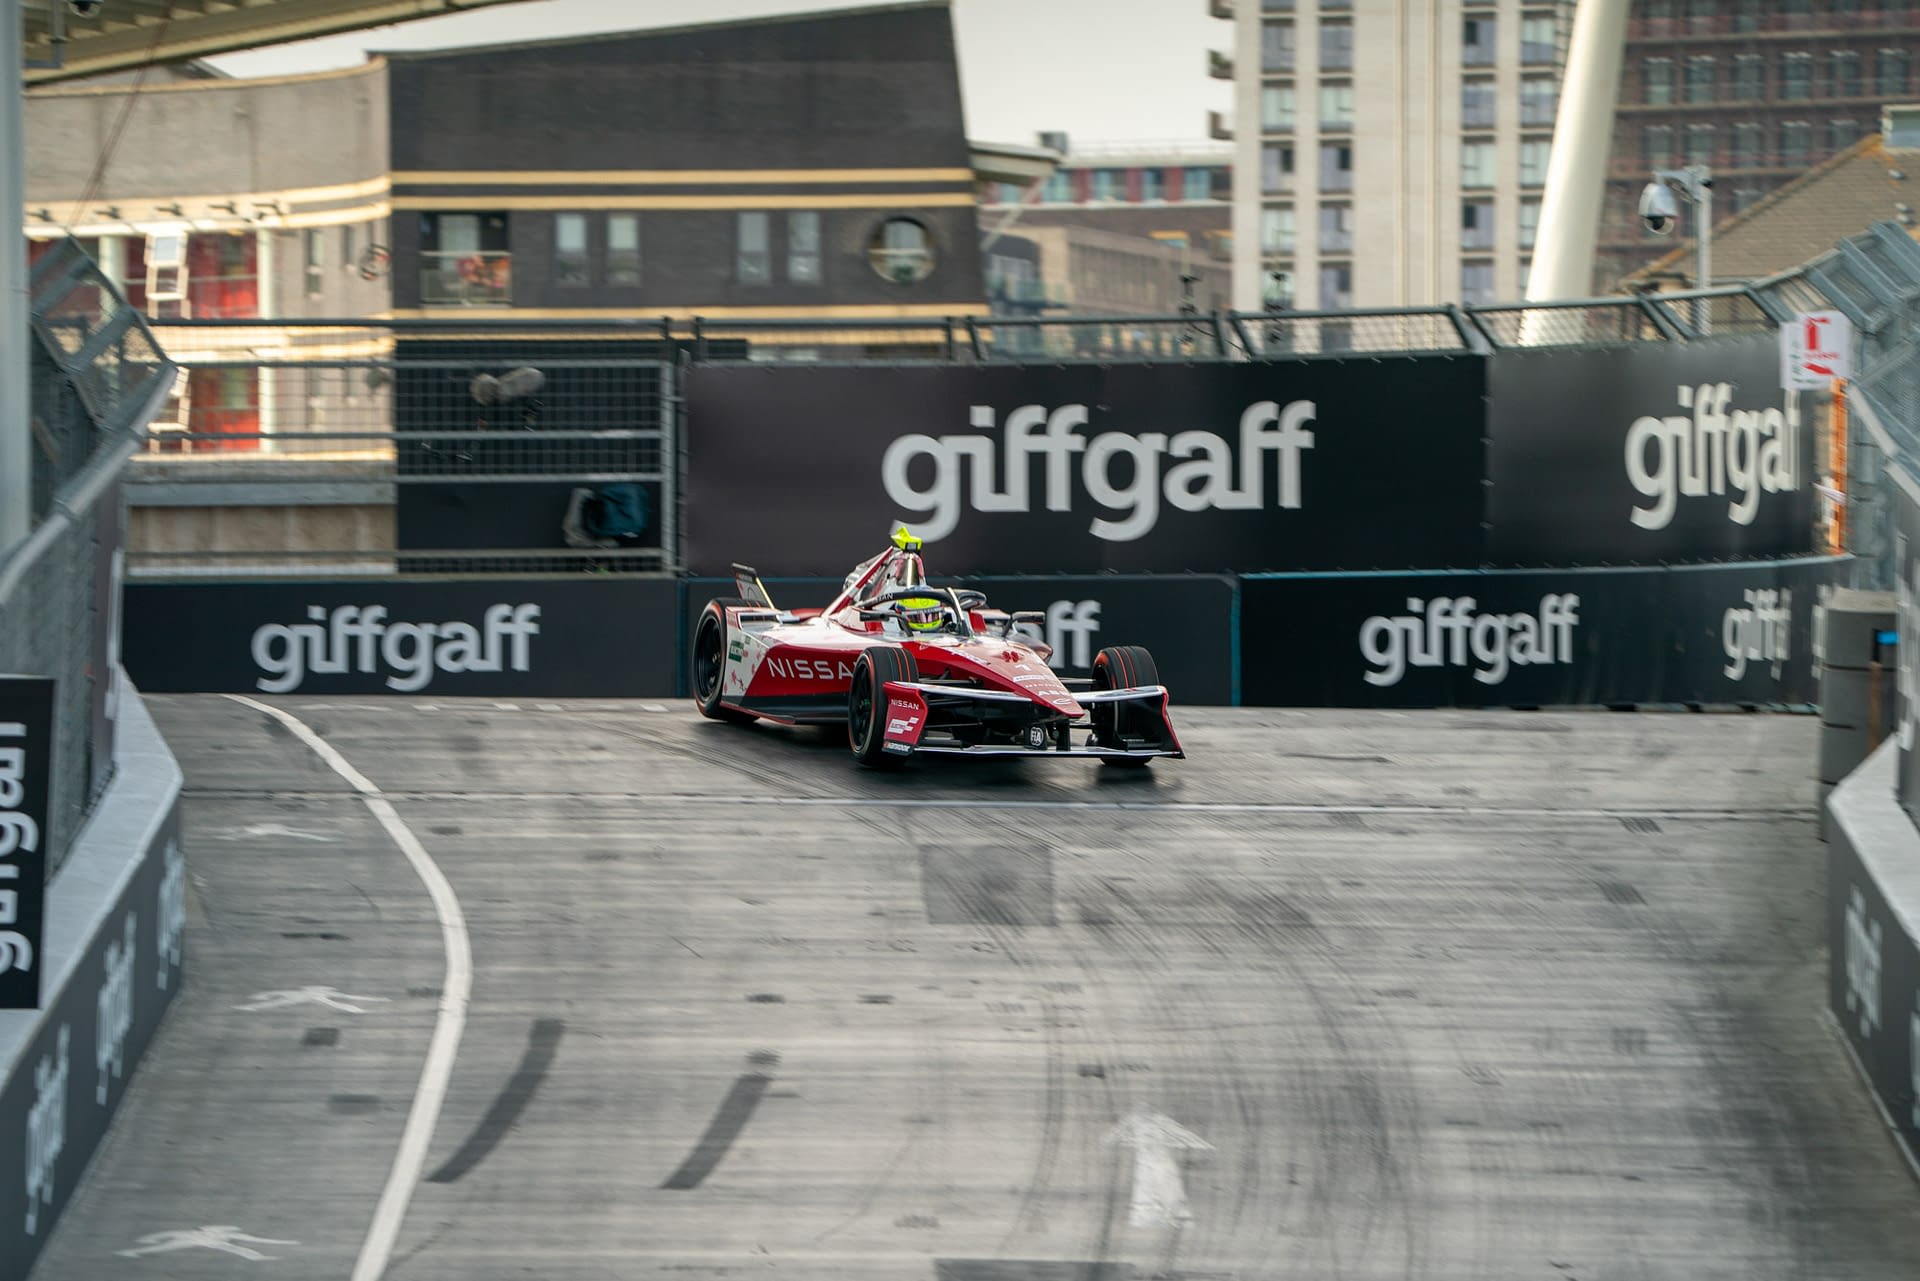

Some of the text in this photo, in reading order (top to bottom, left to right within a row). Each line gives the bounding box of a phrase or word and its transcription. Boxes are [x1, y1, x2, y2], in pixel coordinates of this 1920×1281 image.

[883, 401, 1316, 542] giffgaff
[252, 603, 540, 693] giffgaff
[767, 657, 856, 679] NISSA
[1359, 593, 1580, 686] giffgaff
[891, 699, 920, 711] NISSAN
